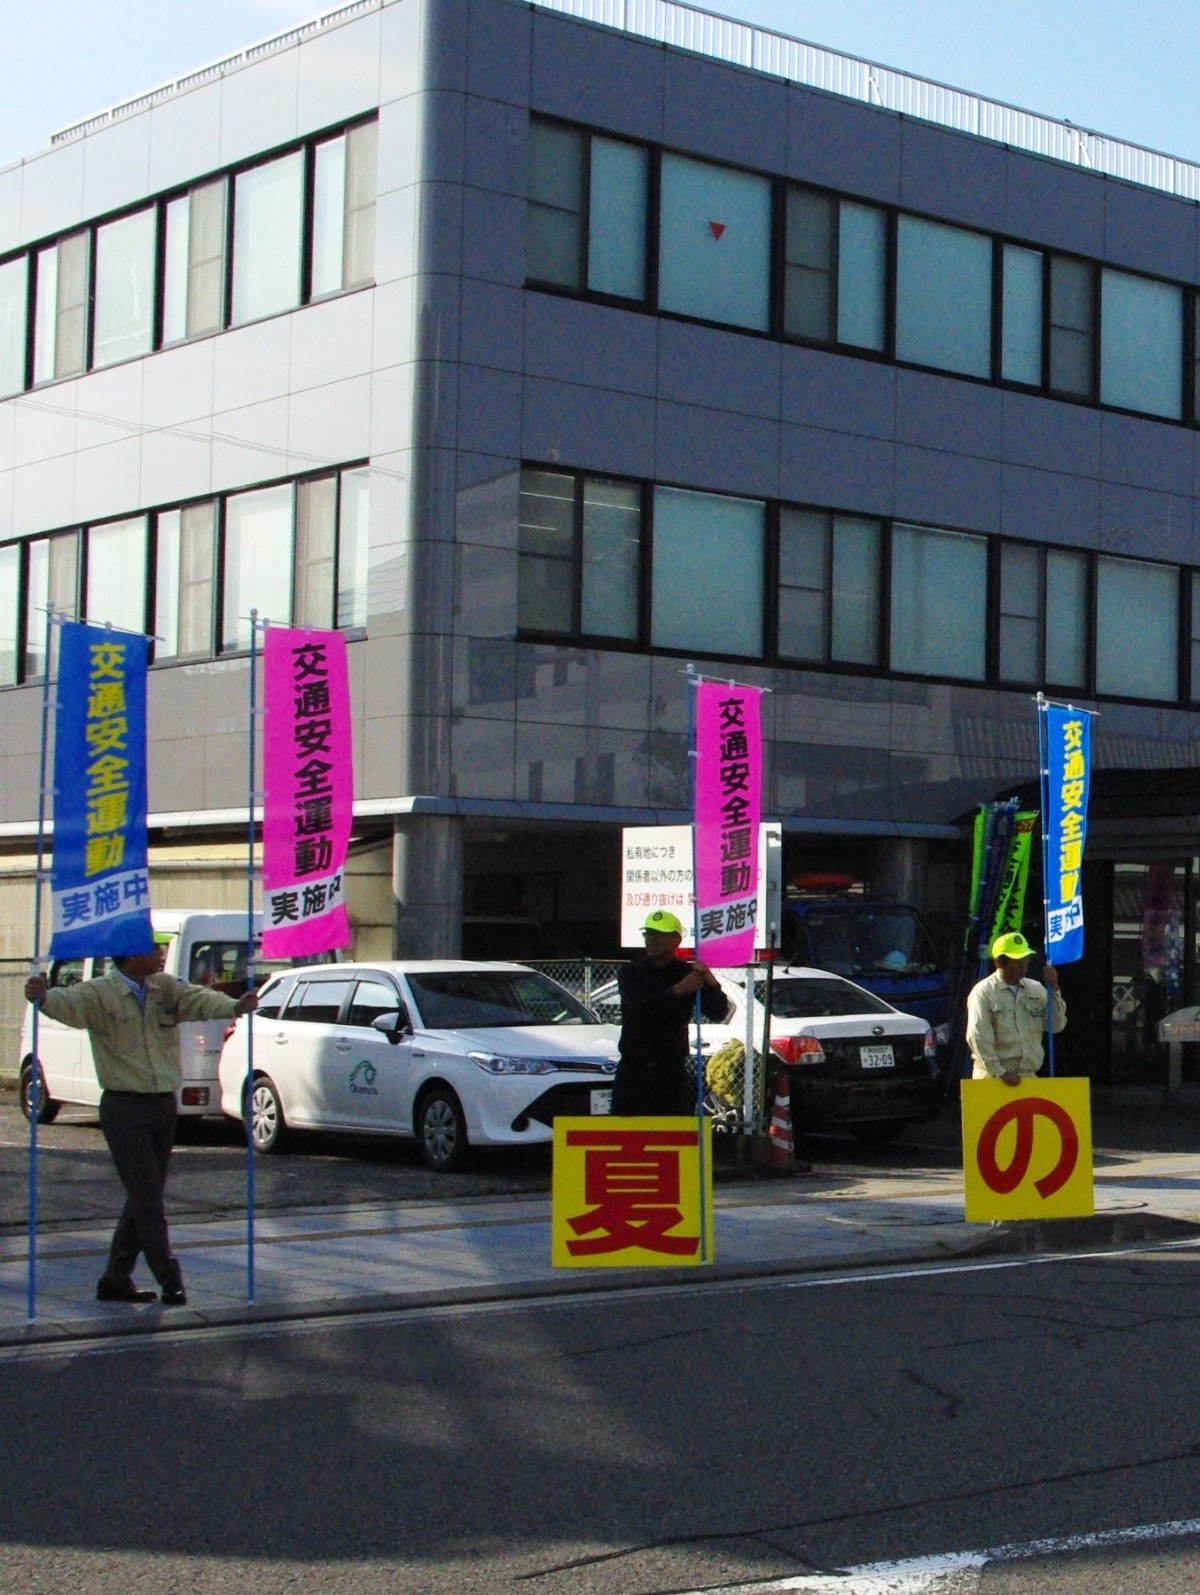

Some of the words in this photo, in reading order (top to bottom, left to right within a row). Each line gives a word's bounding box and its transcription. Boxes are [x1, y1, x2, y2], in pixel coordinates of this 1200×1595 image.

[85, 642, 129, 879] 交通安全運動
[292, 643, 333, 877] 交通安全運動
[719, 698, 751, 896] 交通安全運動
[1059, 720, 1083, 904] 交通安全運動
[62, 872, 149, 927] 実施中
[271, 874, 342, 926] 実施中
[626, 846, 676, 859] 私有地につき
[565, 1130, 700, 1257] 夏
[976, 1097, 1079, 1199] の
